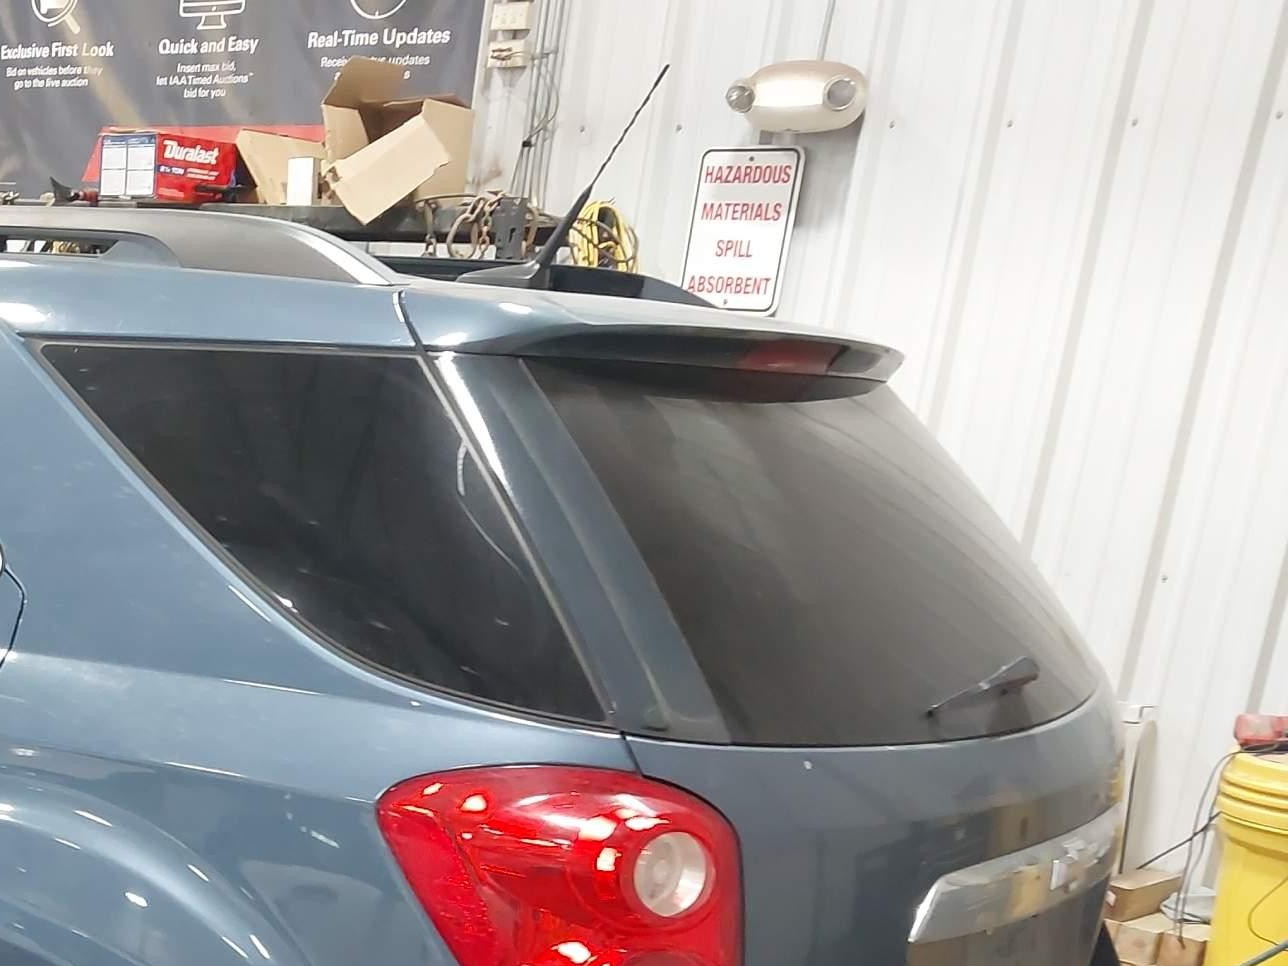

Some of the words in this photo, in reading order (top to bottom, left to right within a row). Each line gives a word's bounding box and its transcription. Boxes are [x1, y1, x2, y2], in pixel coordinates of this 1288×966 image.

[158, 38, 199, 54] Quick
[199, 37, 226, 54] and
[227, 35, 259, 54] Easy
[307, 30, 379, 48] Real-Time
[383, 27, 452, 48] Updates
[0, 43, 50, 60] Exclusive
[51, 41, 79, 57] First
[81, 41, 114, 57] Look
[18, 68, 26, 76] on
[28, 65, 56, 76] vehicles
[58, 64, 82, 75] before
[177, 63, 201, 73] Insert
[202, 64, 220, 72] max
[221, 61, 236, 72] bid,
[14, 80, 24, 90] go
[25, 79, 31, 88] to
[32, 78, 44, 88] the
[45, 77, 60, 88] live
[61, 76, 89, 87] auction
[169, 75, 187, 86] IAA
[187, 75, 212, 85] Timed
[183, 88, 197, 98] bid
[198, 87, 210, 97] for
[211, 89, 226, 99] you
[163, 139, 219, 165] Duralast
[704, 164, 793, 184] HAZARDOUS
[701, 202, 783, 221] MATERIALS
[715, 239, 753, 258] SPILL
[687, 274, 772, 296] ABSORBENT
